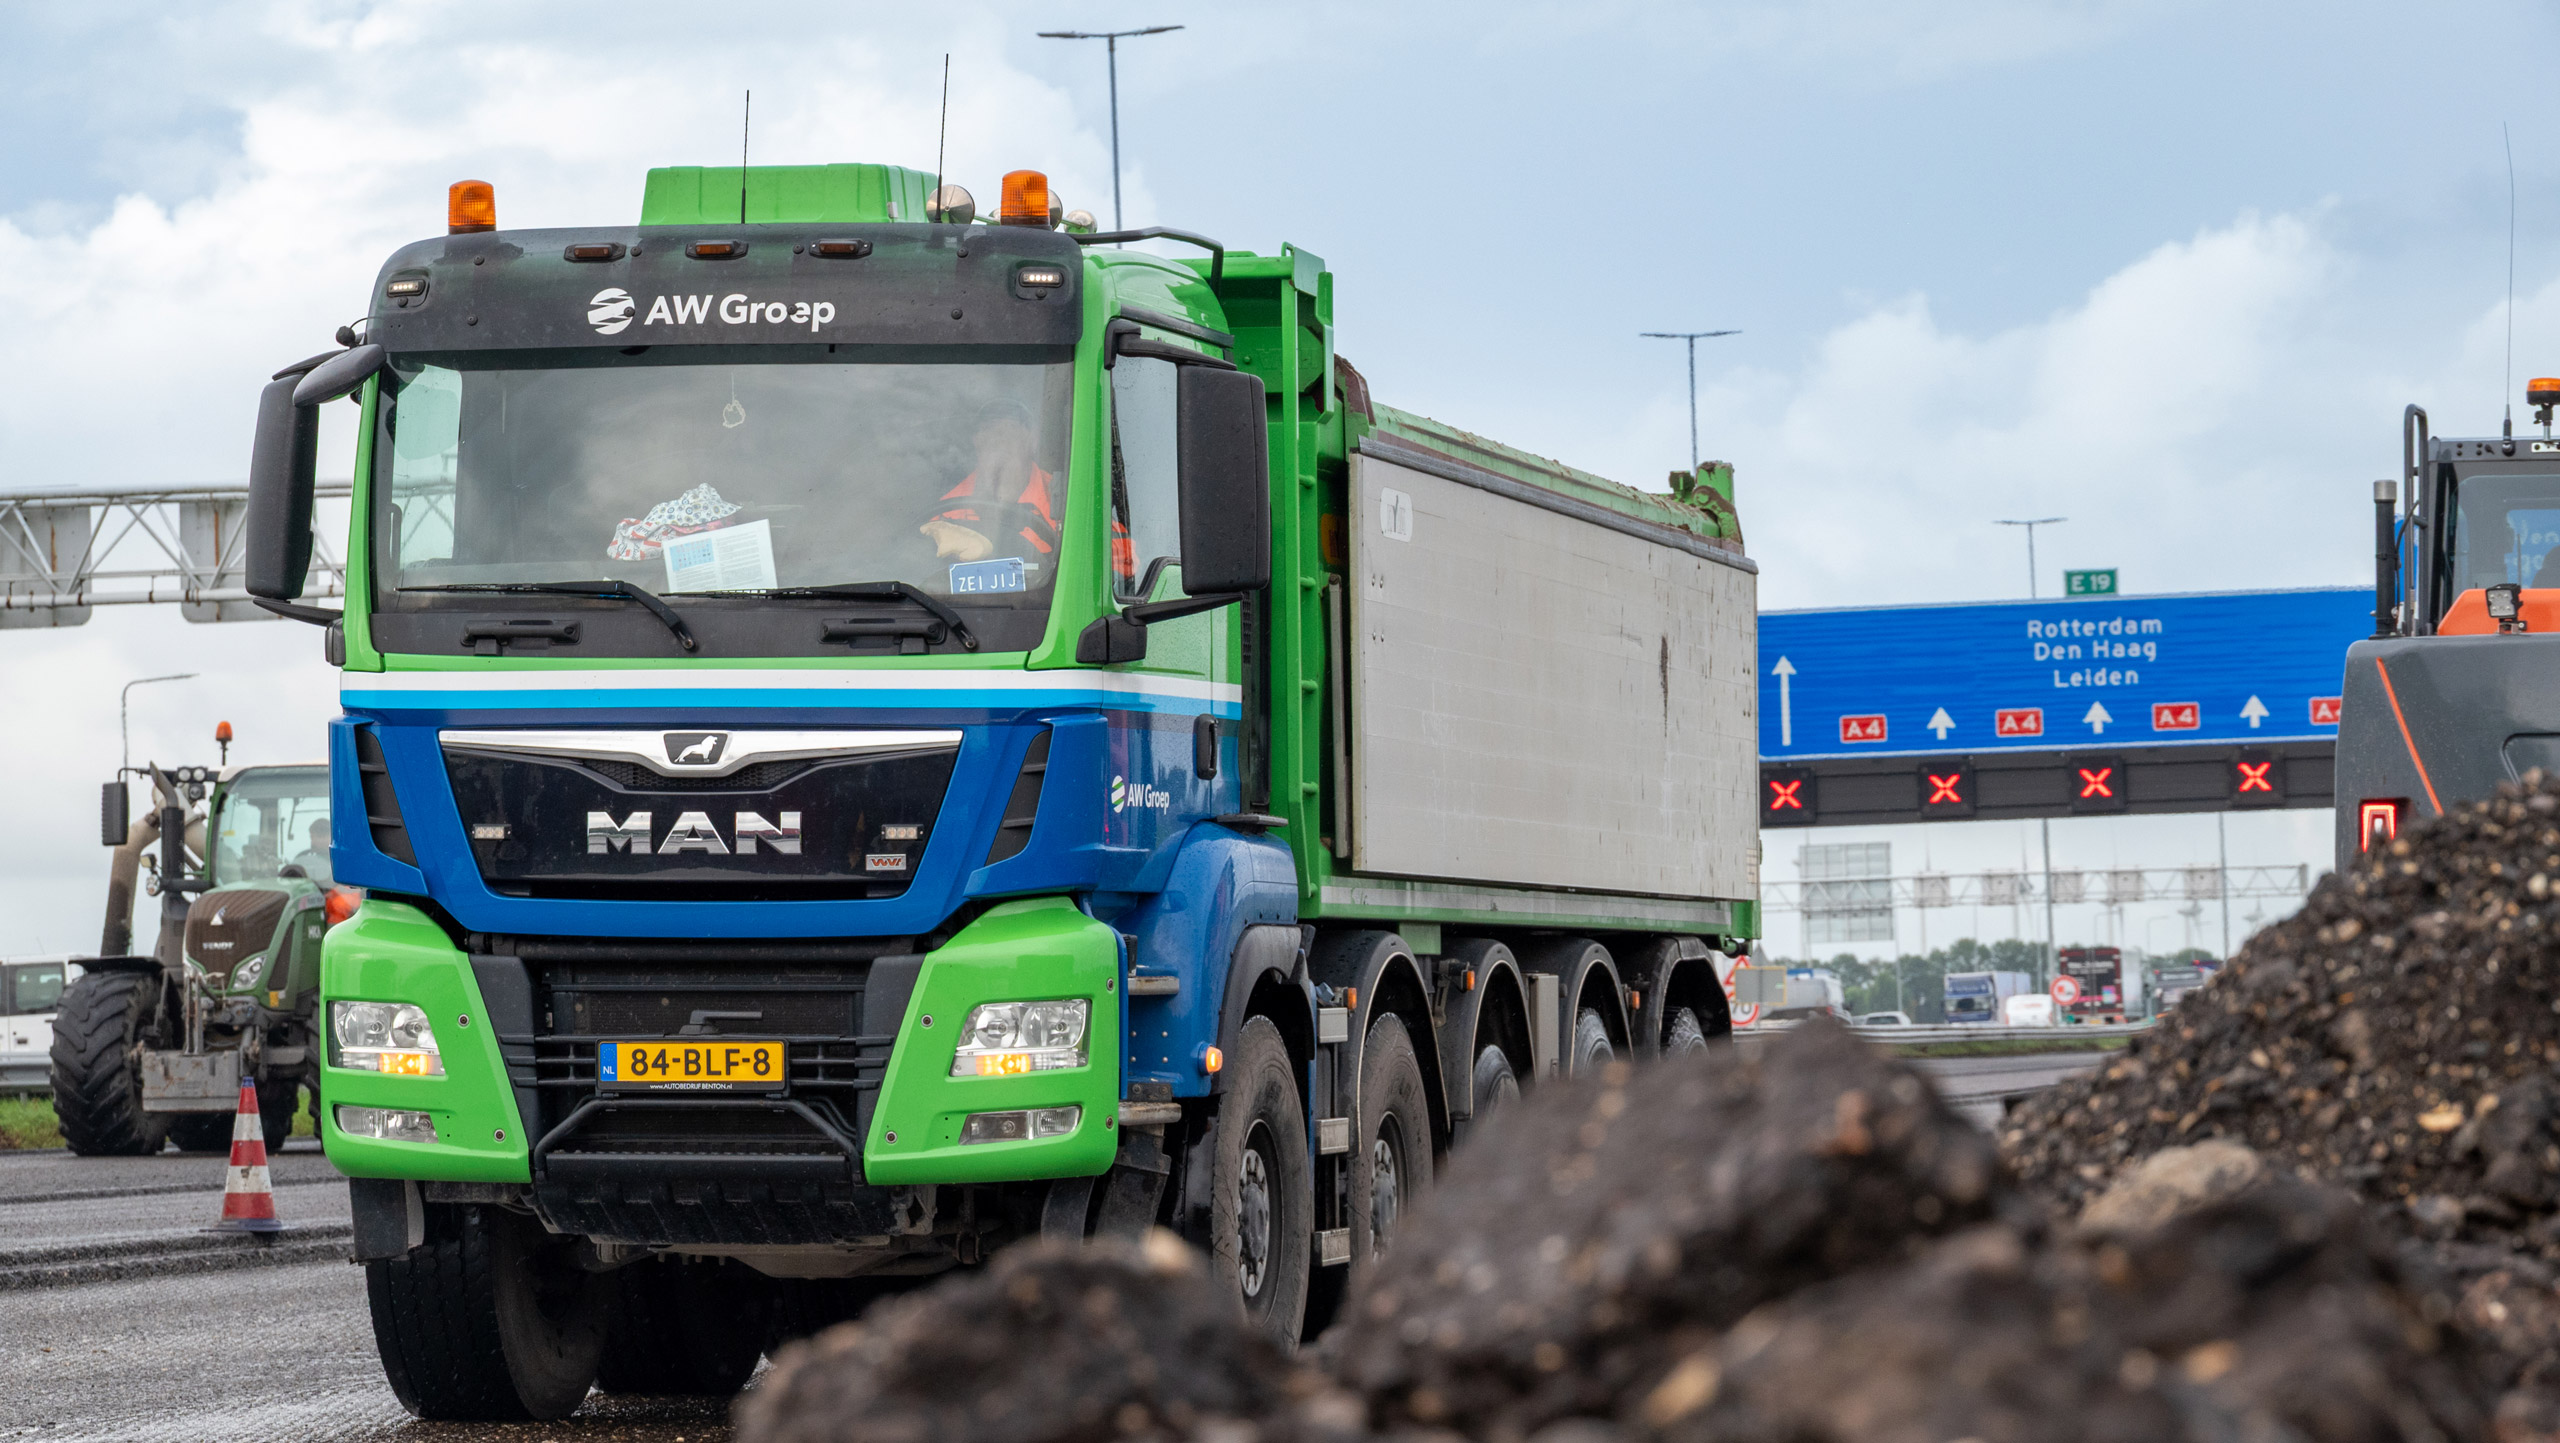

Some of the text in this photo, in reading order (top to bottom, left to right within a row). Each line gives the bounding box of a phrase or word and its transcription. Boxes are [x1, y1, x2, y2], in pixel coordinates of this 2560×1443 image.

[644, 293, 836, 333] AW Groep
[958, 572, 1016, 593] ZEI JIJ
[2071, 573, 2111, 592] E 19
[2027, 616, 2163, 639] Rotterdam
[2034, 639, 2157, 662] Den Haag
[2053, 667, 2139, 688] Leiden
[2158, 707, 2194, 726] A4
[2315, 702, 2341, 721] A
[1847, 718, 1882, 738] A4
[2003, 713, 2037, 732] A4
[1127, 783, 1170, 816] AW Groep
[587, 811, 802, 855] MAN
[602, 1065, 616, 1075] NL
[631, 1048, 771, 1076] 84-BLF-8
